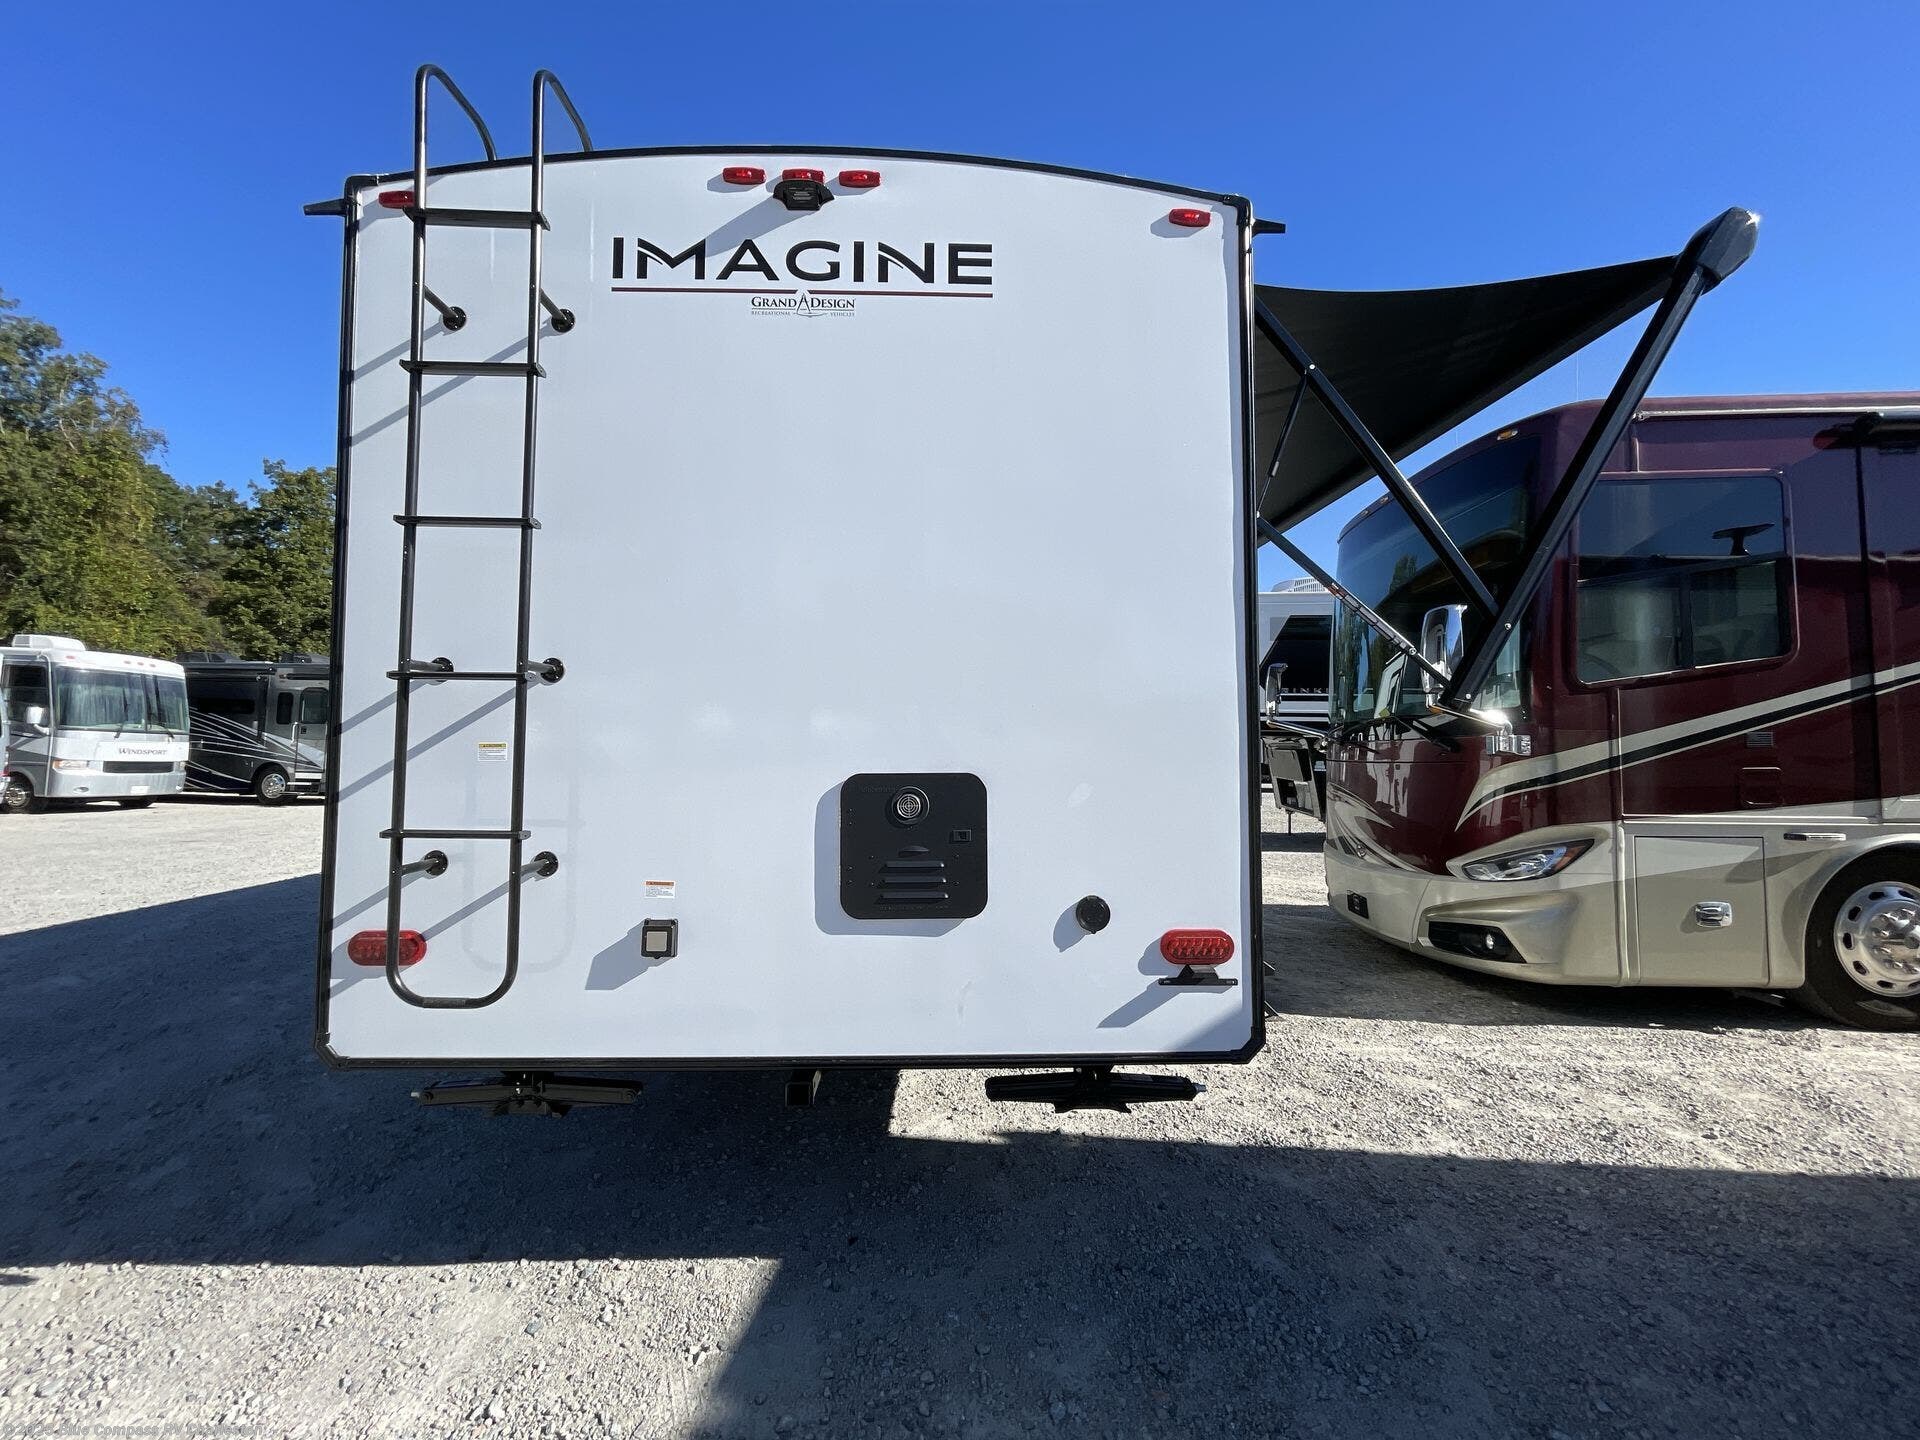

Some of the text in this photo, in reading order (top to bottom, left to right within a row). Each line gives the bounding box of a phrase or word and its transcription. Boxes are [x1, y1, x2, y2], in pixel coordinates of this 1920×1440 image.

[612, 236, 993, 285] IMAGINE
[751, 296, 855, 309] GRAND DESIGN
[119, 747, 168, 755] WINDSPORT
